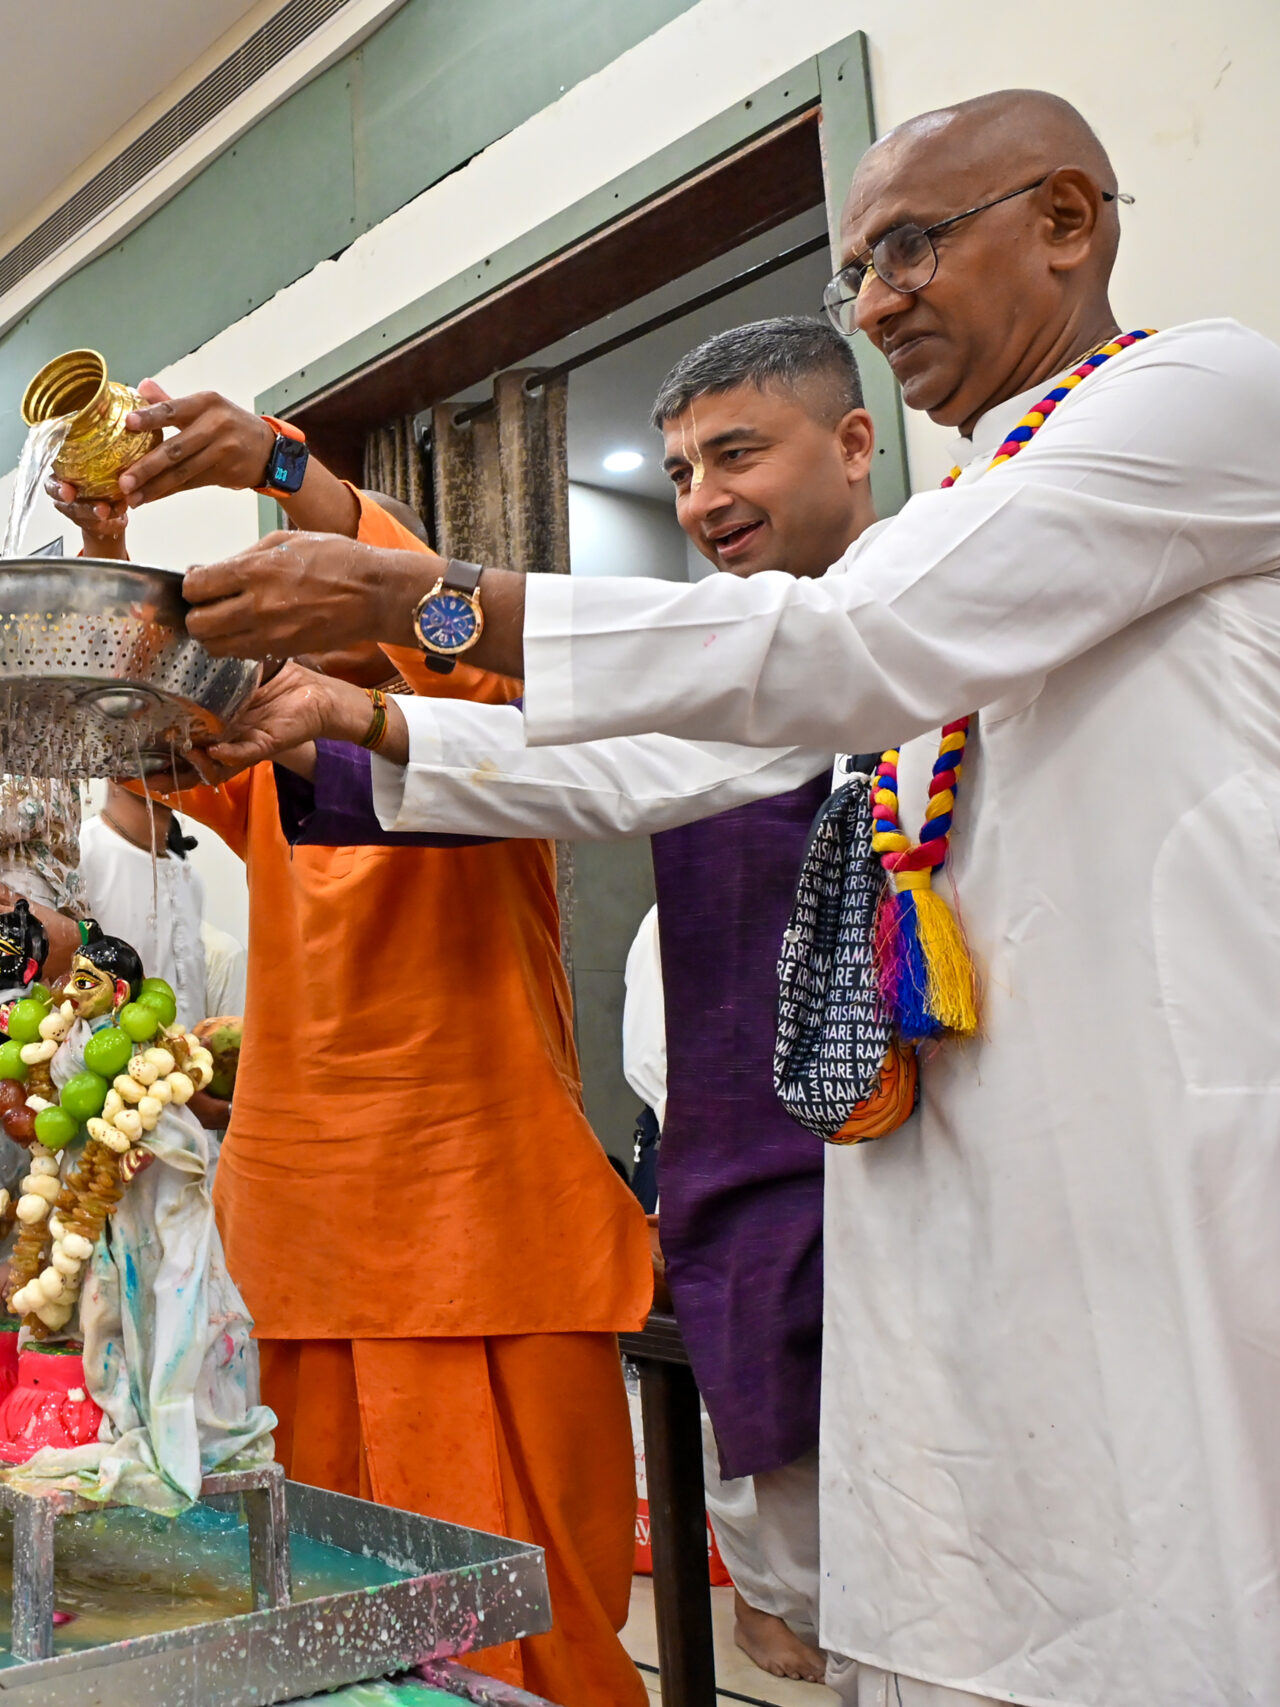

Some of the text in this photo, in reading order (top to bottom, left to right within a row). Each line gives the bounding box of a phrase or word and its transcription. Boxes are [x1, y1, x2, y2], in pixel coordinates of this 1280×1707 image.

[836, 927, 866, 943] HARE
[834, 945, 874, 965] RAMA
[846, 990, 877, 1004] HARE
[824, 1005, 875, 1023] KRISHNA
[821, 1024, 853, 1040] HARE
[820, 1043, 853, 1059] HARE
[820, 1062, 854, 1079] HARE
